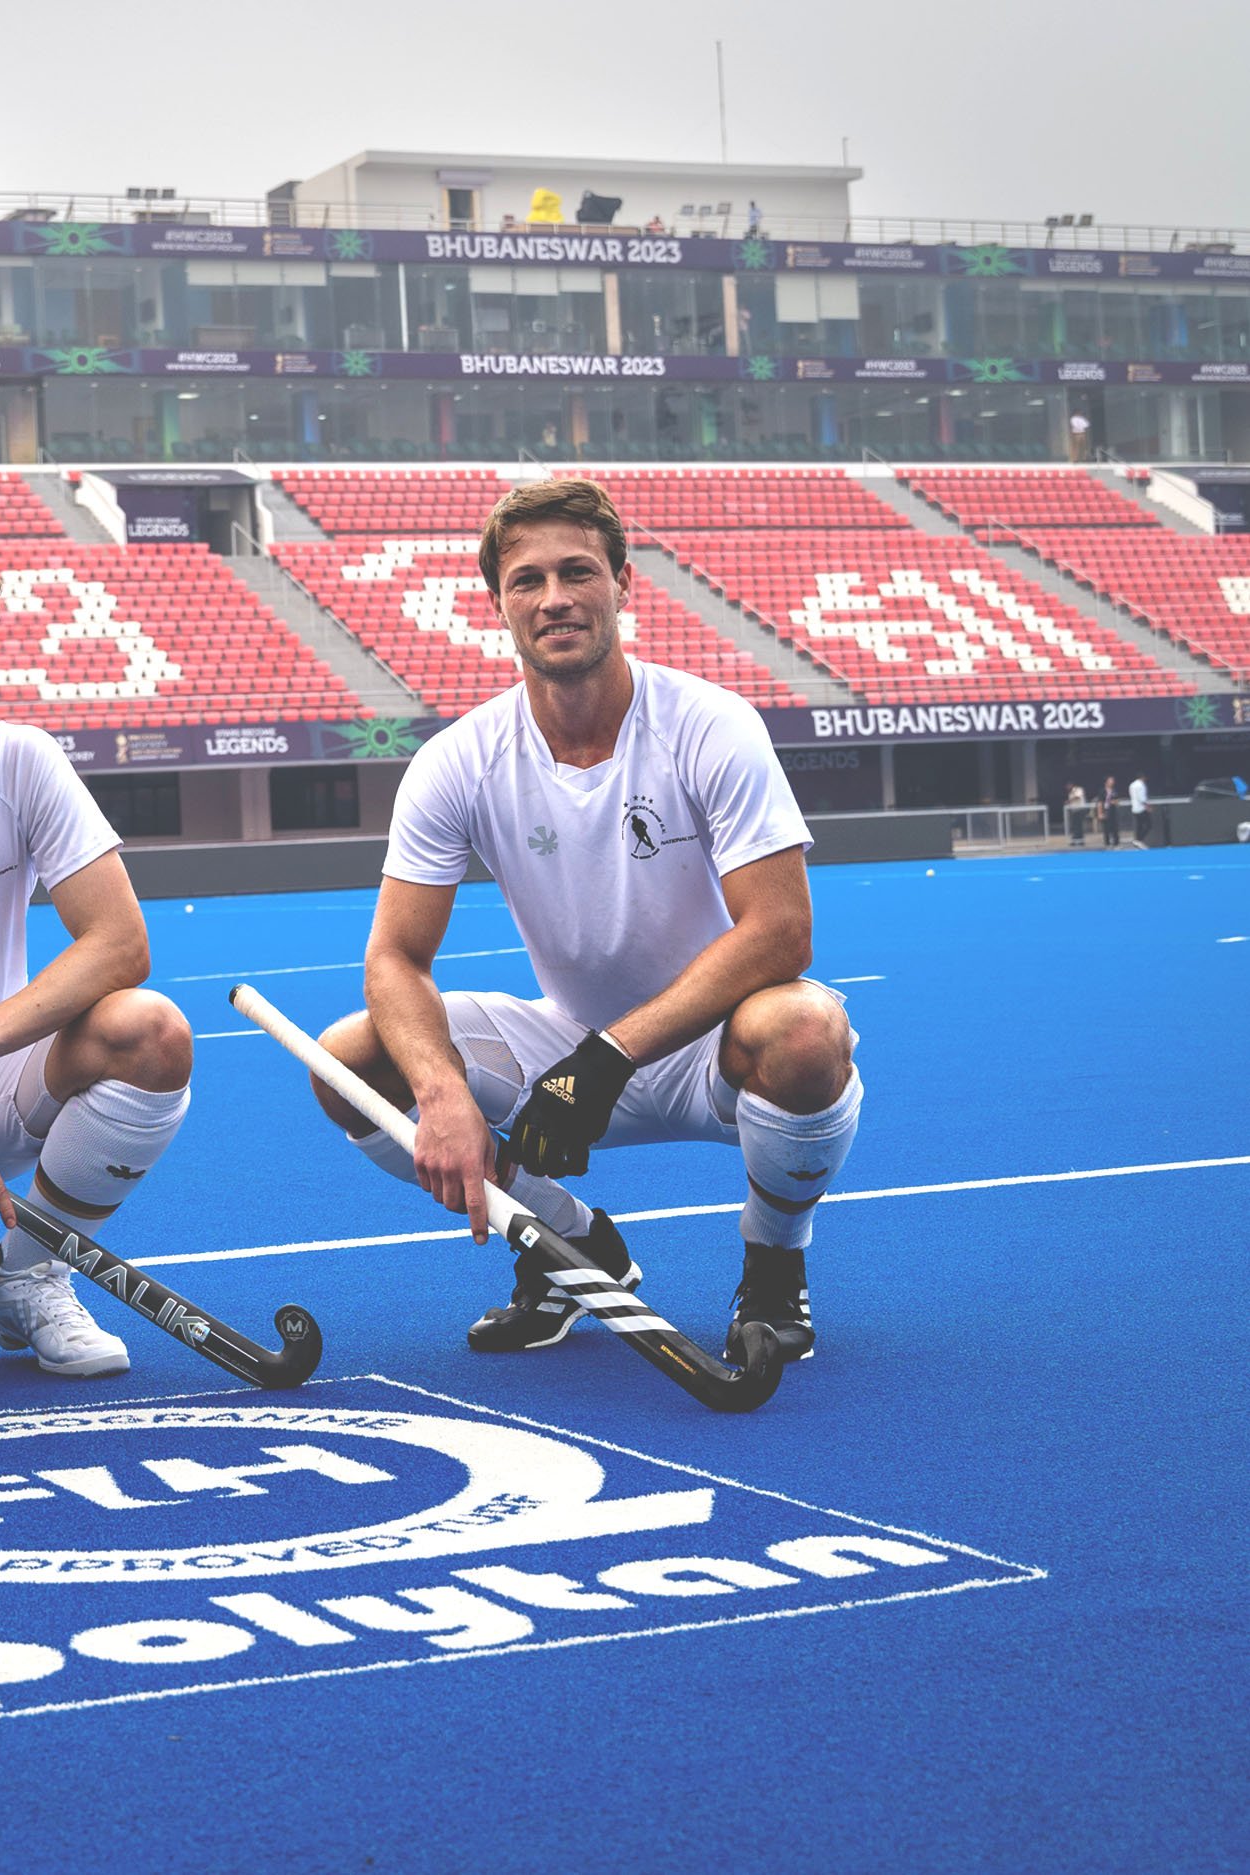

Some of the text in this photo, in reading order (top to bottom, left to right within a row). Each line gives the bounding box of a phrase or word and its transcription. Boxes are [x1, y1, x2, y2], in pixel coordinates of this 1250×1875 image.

[425, 234, 683, 264] BHUBANESWAR 2023
[460, 355, 666, 377] BHUBANESWAR 2023
[127, 523, 190, 537] LEGENDS
[811, 702, 1106, 738] BHUBANESWAR 2023
[205, 735, 289, 756] LEGENDS
[782, 749, 862, 772] EGENDS
[541, 1080, 576, 1105] adidas
[58, 1232, 210, 1348] MALIK
[286, 1319, 303, 1332] M
[419, 1490, 548, 1532] TURF
